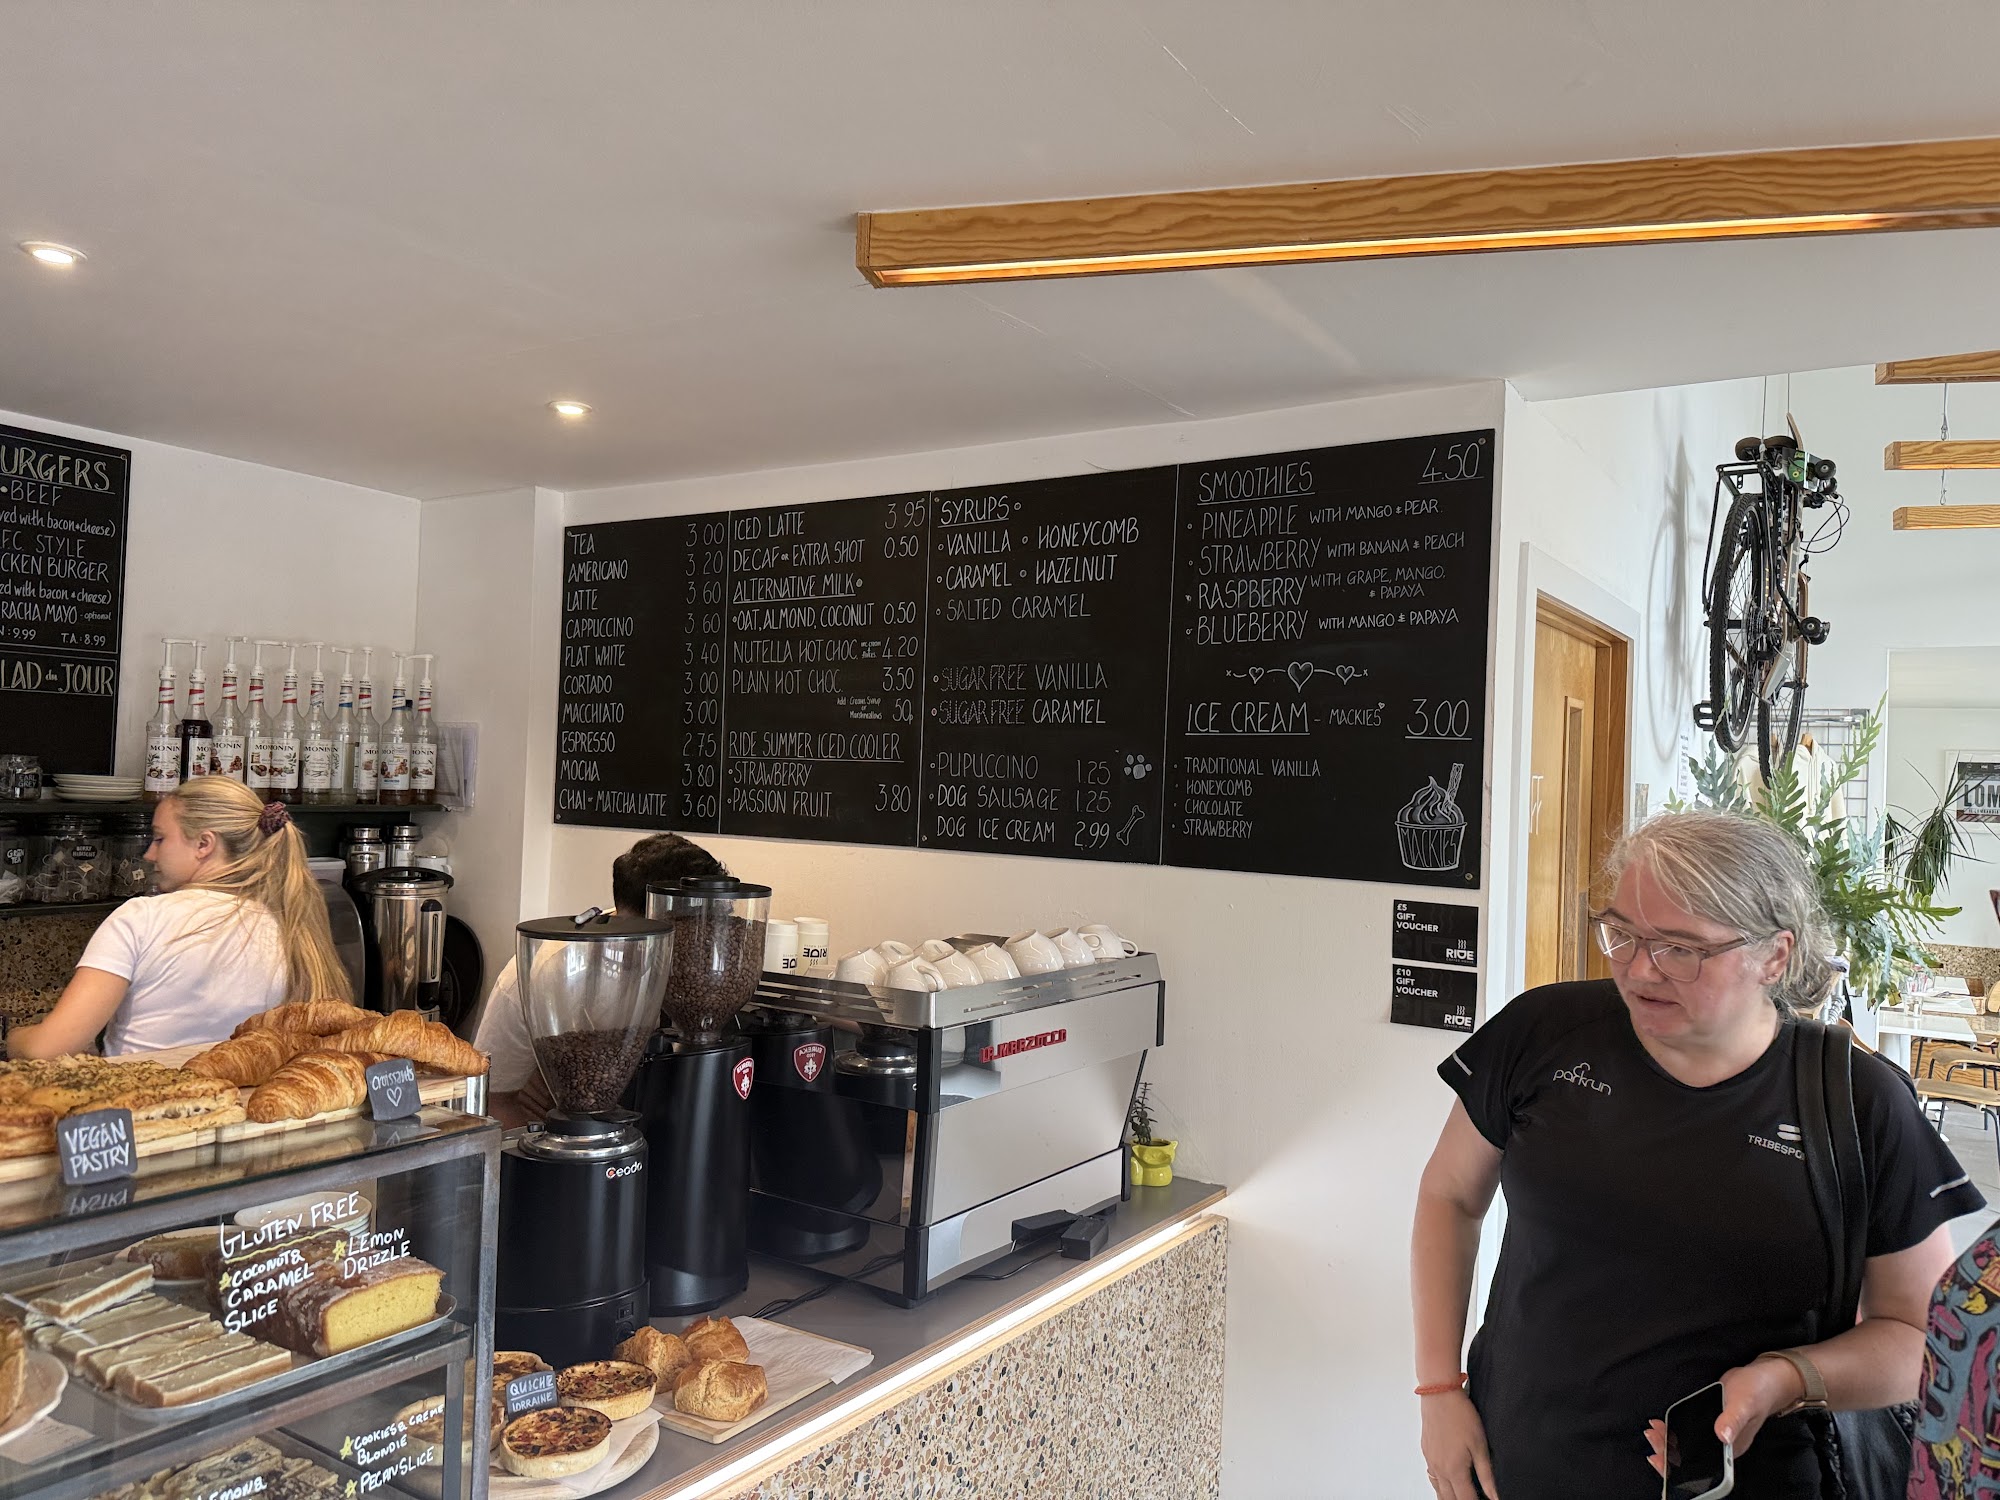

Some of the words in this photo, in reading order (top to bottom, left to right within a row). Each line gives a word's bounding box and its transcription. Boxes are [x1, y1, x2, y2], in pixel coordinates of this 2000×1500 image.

[1198, 461, 1313, 502] SMOOTHIES
[1421, 442, 1480, 482] 4.50
[11, 480, 63, 506] BEEF
[20, 509, 45, 527] with
[47, 511, 76, 531] bacon
[940, 495, 1010, 525] SYRUPS
[1201, 504, 1299, 540] PINEAPPLE
[1309, 506, 1342, 524] WITH
[1345, 505, 1393, 521] MANGO
[734, 517, 762, 541] ICED
[768, 511, 805, 538] LATTE
[947, 529, 1011, 556] VANILLA
[1038, 517, 1140, 549] HONEYCOMB
[36, 534, 86, 558] STYLE
[571, 533, 595, 555] TEA
[733, 546, 780, 572] DECAF
[792, 542, 830, 567] EXTRA
[834, 539, 866, 564] SHOT
[884, 535, 919, 559] 0.50
[1198, 537, 1321, 576] STRAWBERRY
[1327, 542, 1355, 558] WITH
[1359, 538, 1410, 556] BANANA
[1424, 531, 1465, 550] PEACH
[47, 557, 109, 583] BURGER
[568, 559, 628, 583] AMERICANO
[946, 562, 1012, 590] CARAMEL
[1035, 554, 1118, 585] HAZELNUT
[14, 580, 36, 597] with
[39, 580, 69, 600] bacon
[567, 589, 598, 612] LATTE
[733, 575, 816, 602] ALTERNATIVE
[822, 573, 855, 596] MILK
[1198, 575, 1308, 610] RASPBERRY
[1310, 573, 1342, 588] WITH
[1346, 567, 1392, 585] GRAPE,
[1380, 582, 1425, 599] PAPAYA
[44, 604, 77, 624] MAYO
[820, 603, 875, 628] COCONUT
[883, 602, 917, 625] 0.50
[946, 598, 1002, 621] SALTED
[1011, 593, 1092, 619] CARAMEL
[566, 616, 634, 639] CAPPUCCINO
[1197, 610, 1309, 645] BLUEBERRY
[1318, 617, 1345, 630] WITH
[1348, 613, 1395, 629] MANGO
[1410, 608, 1459, 626] PAPAYA
[565, 645, 591, 668] FLAT
[595, 644, 626, 667] WHITE
[733, 639, 793, 663] NUTELLA
[799, 639, 824, 663] HOT
[882, 636, 918, 659] 4.20
[58, 663, 114, 695] JOUR
[563, 674, 613, 695] CORTADO
[732, 669, 769, 694] PLAIN
[775, 669, 802, 694] HOT
[882, 667, 914, 692] 3.50
[1035, 663, 1108, 691] VANILLA
[562, 702, 624, 724] MACCHIATO
[892, 698, 914, 725] 50p
[1032, 699, 1106, 724] CARAMEL
[1187, 702, 1222, 732] ICE
[1230, 702, 1309, 732] CREAM
[1329, 708, 1381, 727] MACKIES
[1406, 698, 1470, 737] 3.00
[561, 731, 616, 753] ESPRESSO
[729, 731, 758, 756] RIDE
[763, 731, 814, 758] SUMMER
[817, 733, 846, 759] ICED
[850, 733, 901, 760] COOLER
[560, 759, 600, 781] MOCHA
[734, 761, 813, 787] STRAWBERRY
[937, 751, 1039, 780] PUPUCCINO
[1076, 759, 1111, 785] 1.25
[1184, 756, 1264, 776] TRADITIONAL
[1271, 759, 1321, 777] VANILLA
[732, 787, 787, 814] PASSION
[793, 791, 832, 817] FRUIT
[874, 784, 911, 813] 3.80
[937, 784, 968, 807] DOG
[977, 785, 1061, 811] SAUSAGE
[1076, 790, 1112, 813] 1.25
[1186, 779, 1253, 796] HONEYCOMB
[559, 788, 586, 810] CHAI
[595, 790, 636, 814] MATCHA
[638, 793, 667, 817] LATTE
[1184, 798, 1243, 817] CHOCOLATE
[937, 816, 967, 838] DOG
[978, 818, 1000, 840] ICE
[1005, 819, 1055, 843] CREAM
[1074, 821, 1110, 849] 2.99
[1183, 819, 1253, 839] STRAWBERRY
[1401, 828, 1460, 869] MACKIES
[1396, 903, 1408, 912] £5
[1396, 912, 1416, 921] GIFT
[1396, 921, 1439, 933] VOUCHER
[1445, 948, 1475, 960] RIDE
[1395, 968, 1412, 977] £10
[1395, 977, 1416, 986] GIFT
[1395, 986, 1438, 998] VOUCHER
[1443, 1014, 1472, 1027] RIDE
[1552, 1066, 1612, 1096] parkrun
[64, 1117, 127, 1155] VEGAN
[70, 1142, 130, 1179] PASTRY
[220, 1213, 303, 1258] GLUTEN
[310, 1190, 360, 1229] FREE
[231, 1251, 293, 1288] COCONUT
[343, 1240, 411, 1280] DRIZZLE
[227, 1262, 315, 1308] CARAMEL
[224, 1298, 279, 1335] SLICE
[510, 1374, 554, 1396] QUICHE
[511, 1391, 553, 1413] LORRAINE
[353, 1422, 396, 1450] COOKIES
[408, 1403, 445, 1426] CREME
[357, 1434, 408, 1466] BLONDIE
[360, 1463, 399, 1494] PECAN
[399, 1445, 435, 1476] SLICE
